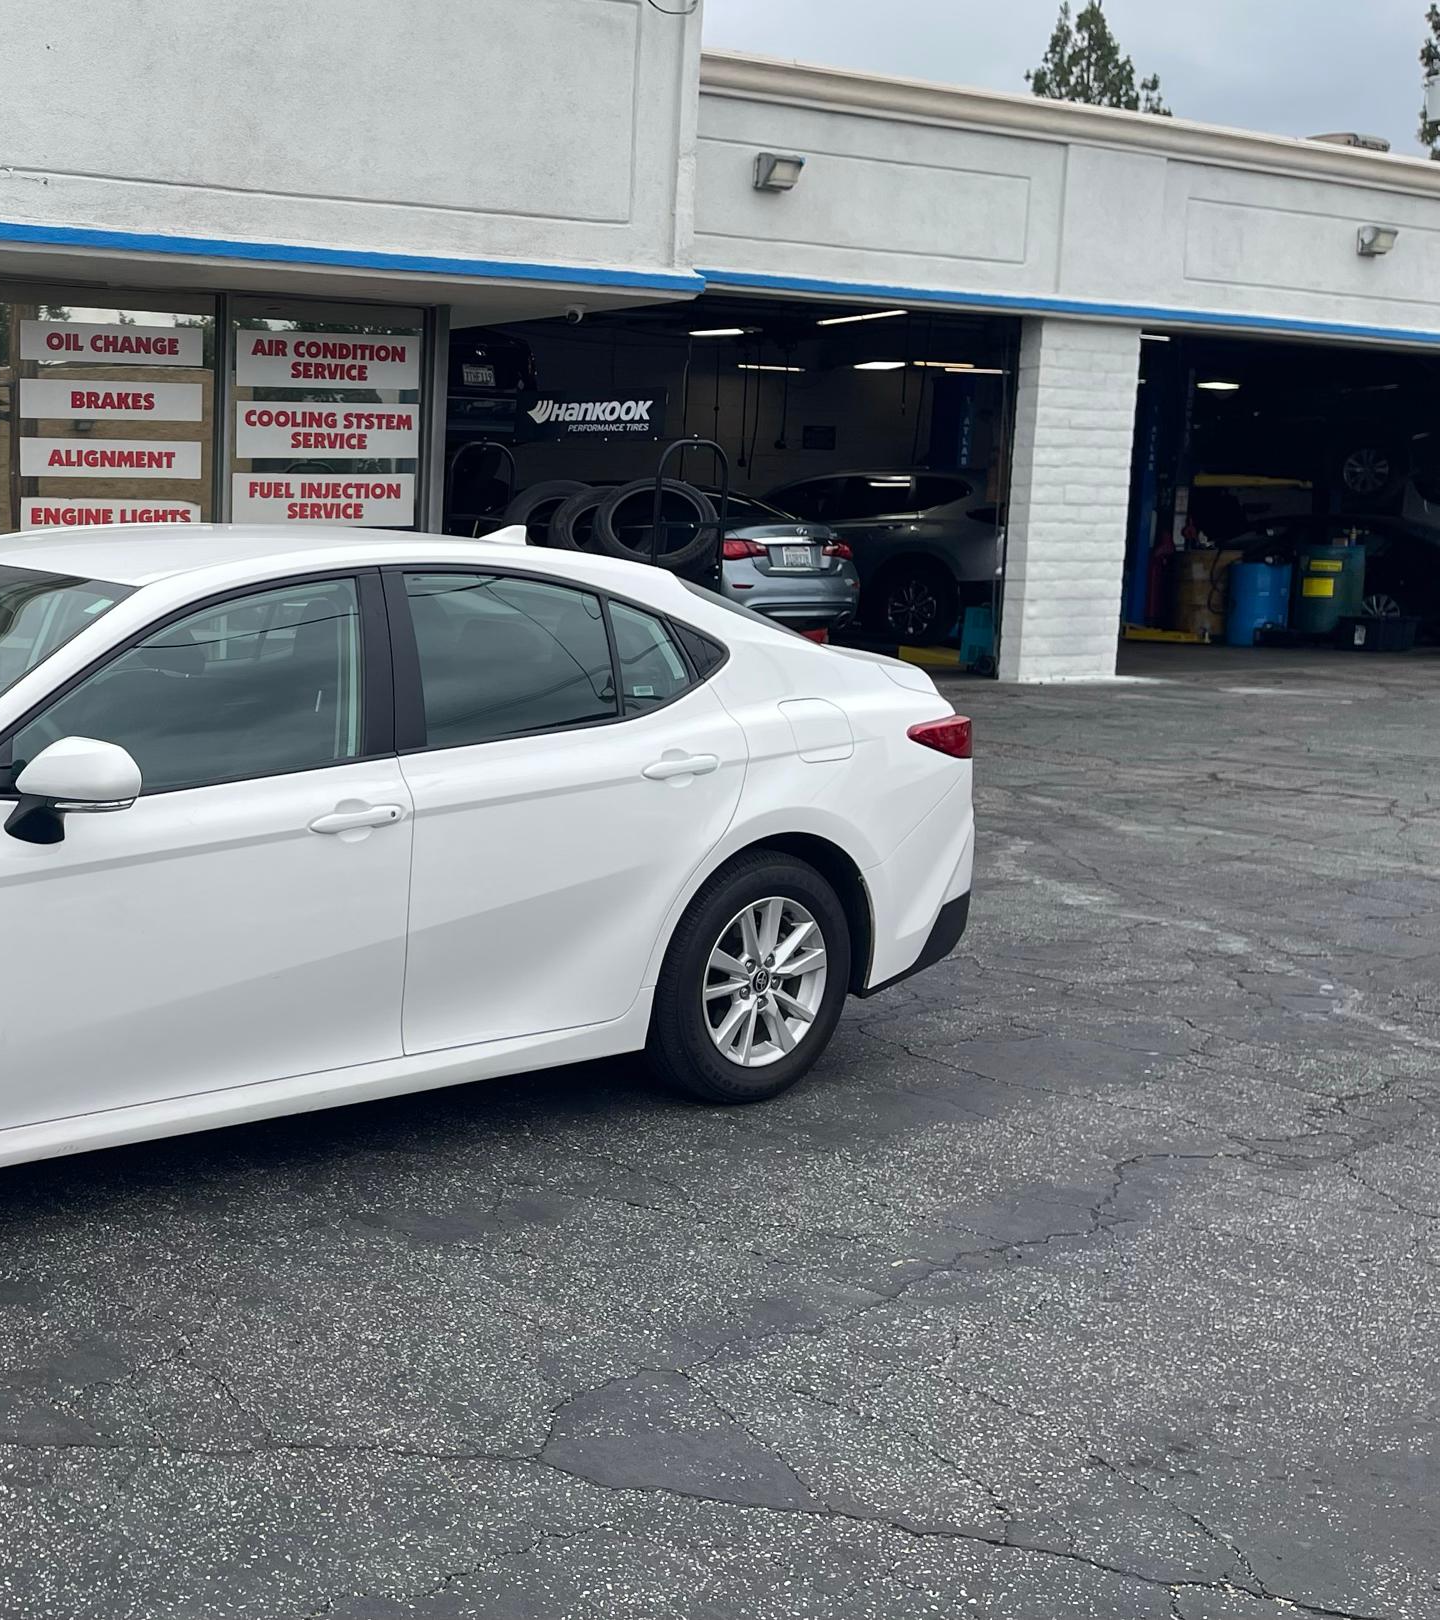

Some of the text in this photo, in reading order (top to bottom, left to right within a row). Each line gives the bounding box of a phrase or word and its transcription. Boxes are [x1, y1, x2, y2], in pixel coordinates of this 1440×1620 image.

[46, 332, 179, 355] OIL CHANGE
[251, 338, 406, 362] AIR CONDITION
[290, 361, 368, 381] SERVICE
[71, 391, 155, 410] BRAKES
[245, 409, 337, 428] COOLING
[568, 423, 649, 432] PERFORMANCE TIRES
[290, 431, 368, 449] SERVICE
[48, 449, 175, 468] ALIGNMENT
[248, 481, 401, 499] FUEL INJECTION
[31, 507, 191, 525] ENGINE LIGHTS
[287, 502, 364, 520] SERVICE
